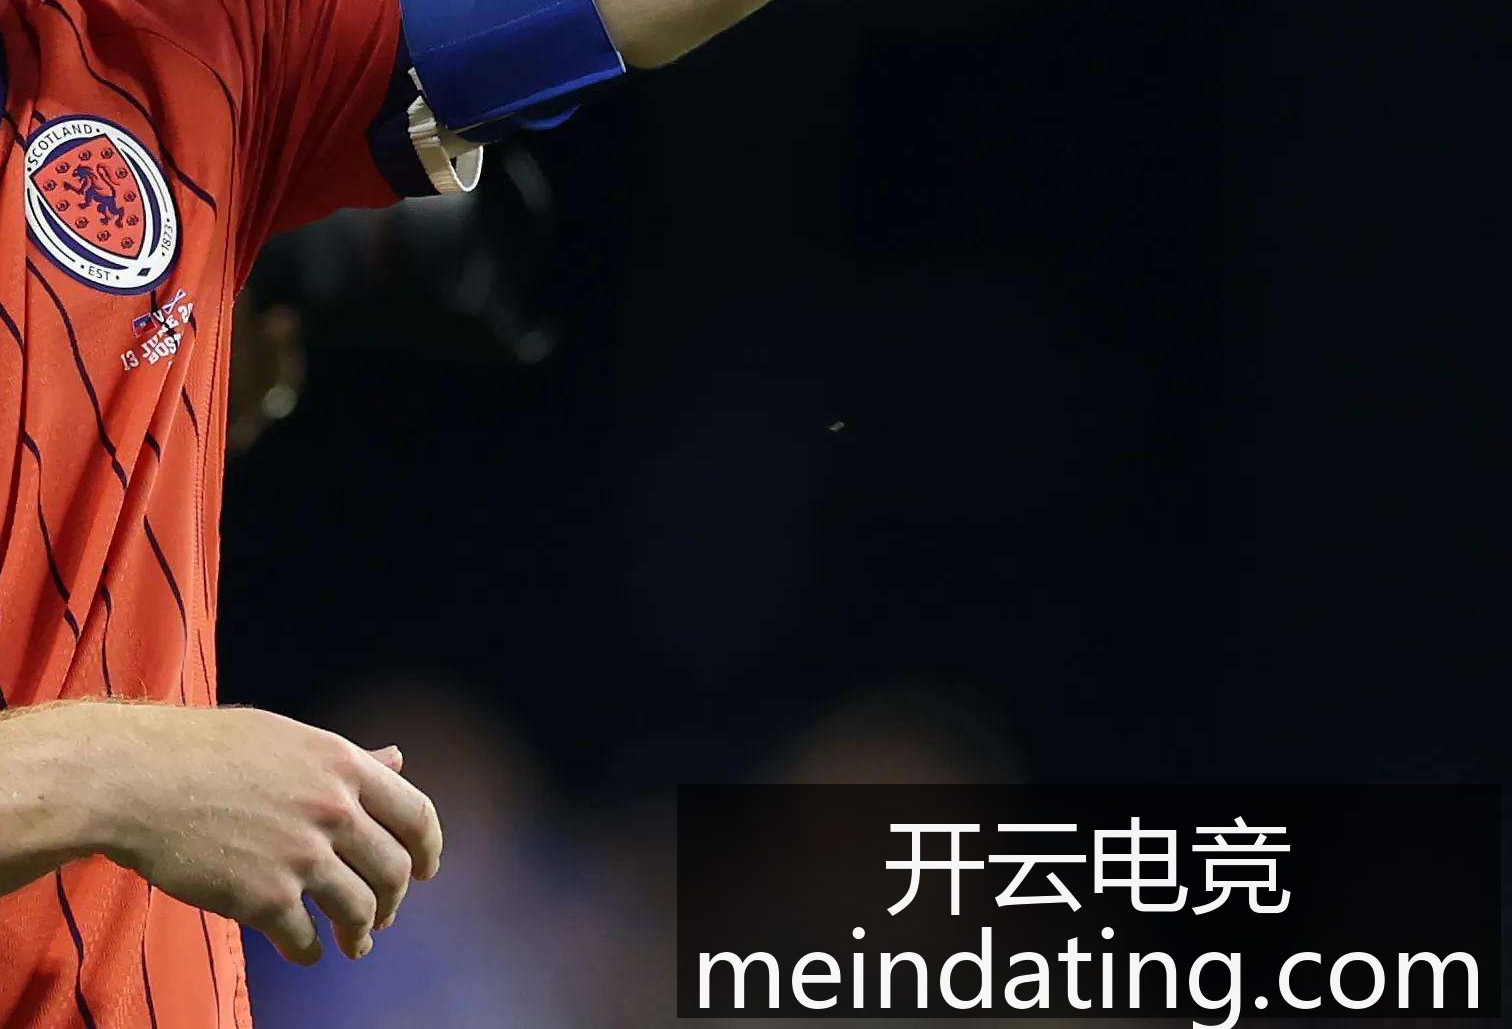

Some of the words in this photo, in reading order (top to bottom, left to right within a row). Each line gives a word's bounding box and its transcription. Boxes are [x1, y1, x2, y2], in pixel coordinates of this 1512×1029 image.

[28, 123, 93, 166] SCOTLAND
[161, 224, 174, 252] 1873
[88, 267, 111, 281] EST
[120, 350, 140, 371] 13
